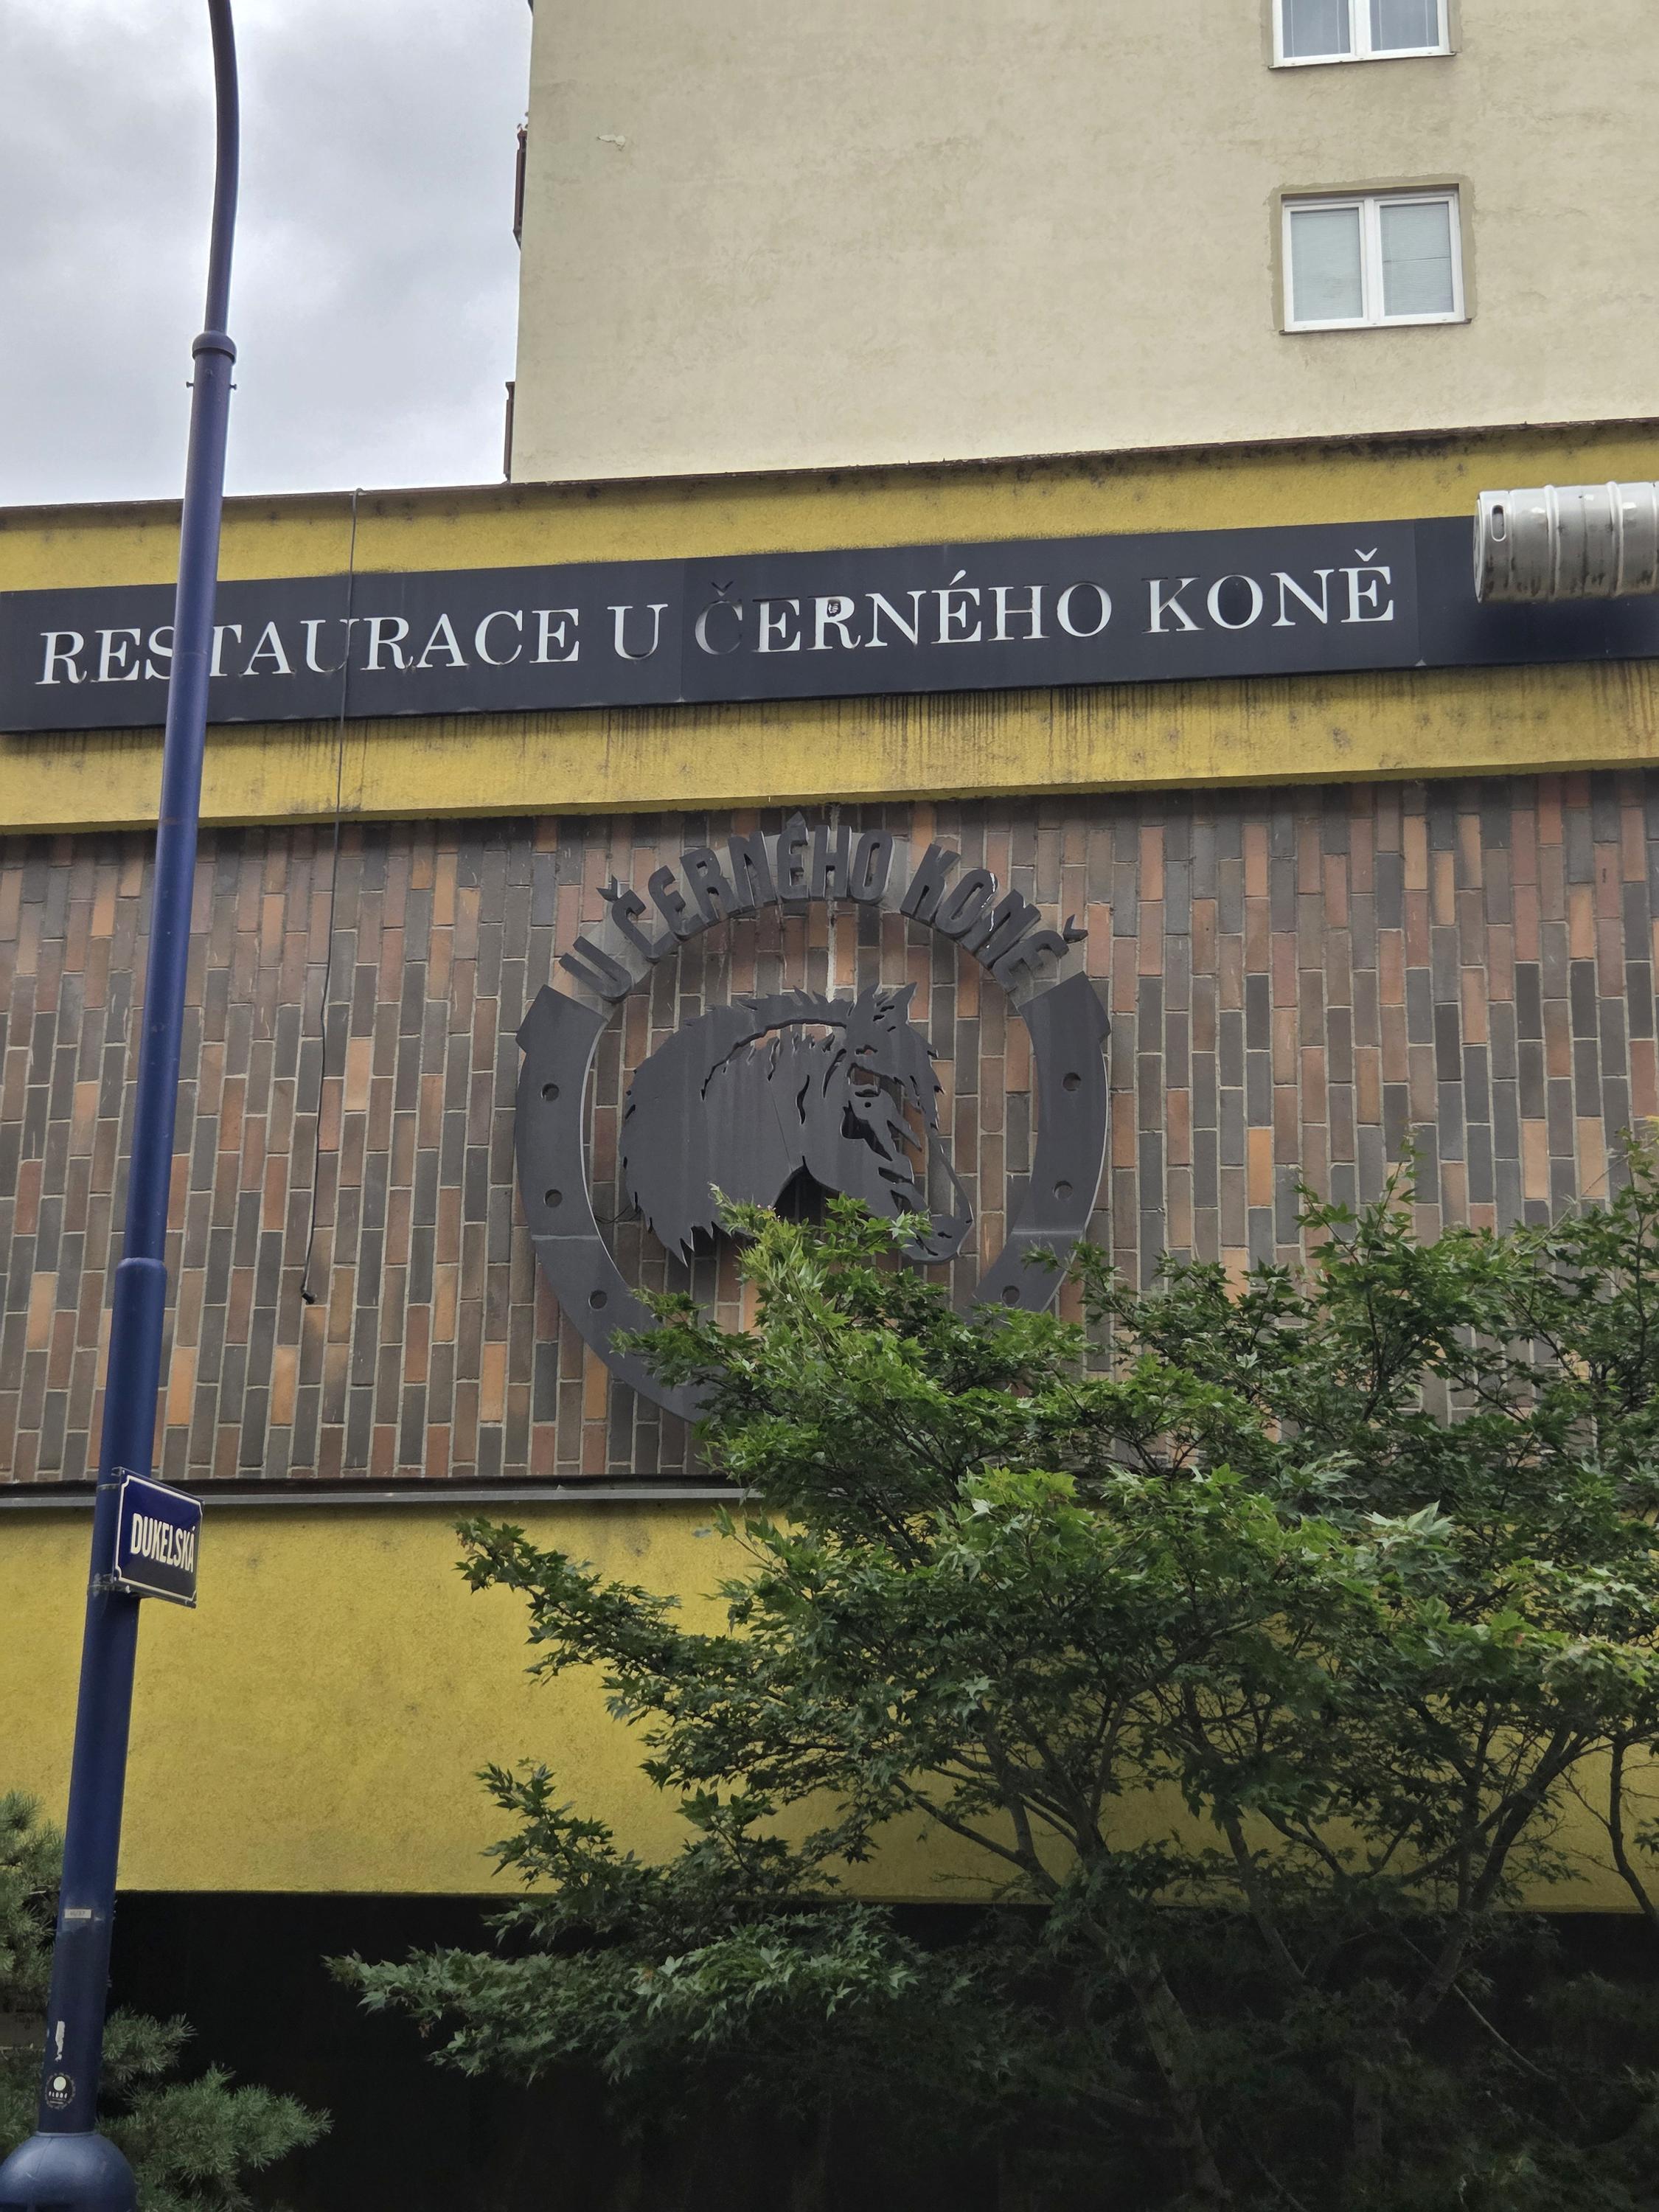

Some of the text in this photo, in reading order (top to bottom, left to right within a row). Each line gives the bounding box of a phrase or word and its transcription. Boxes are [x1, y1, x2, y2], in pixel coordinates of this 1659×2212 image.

[35, 548, 1394, 685] RESTAURACE U ČERNÉHO KONĚ
[559, 811, 1089, 1003] U ČERNÉHO KONĚ
[130, 1512, 195, 1573] DUKELSKÁ
